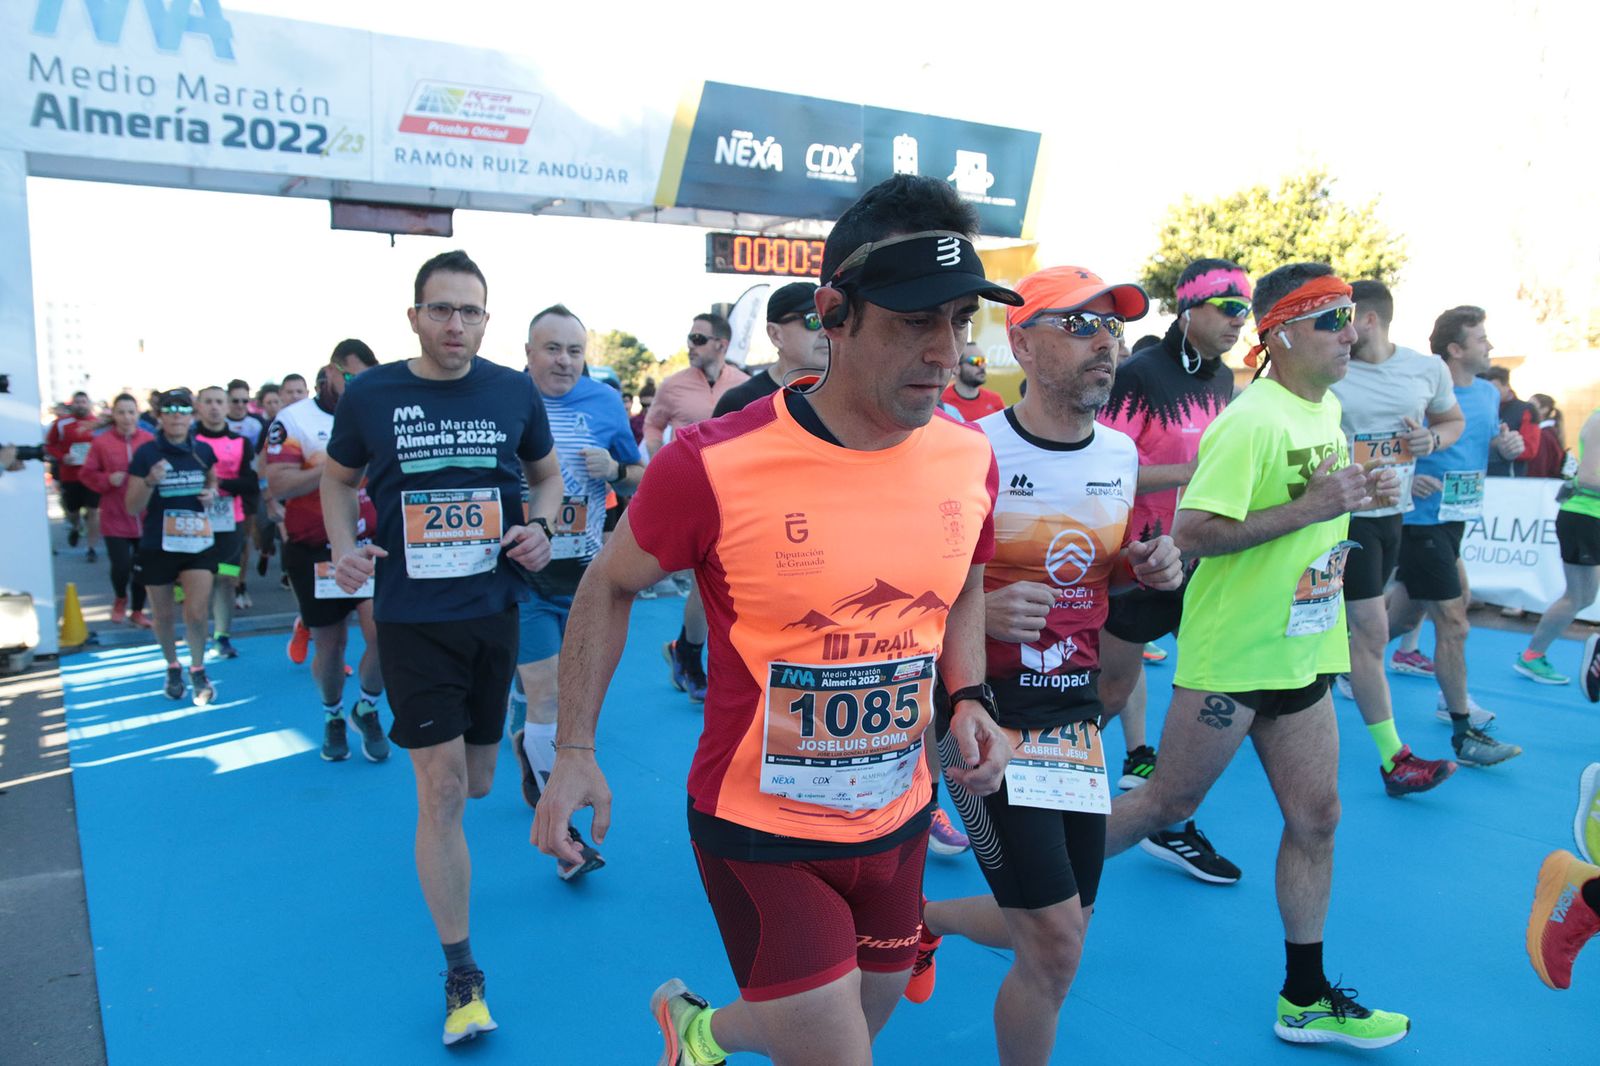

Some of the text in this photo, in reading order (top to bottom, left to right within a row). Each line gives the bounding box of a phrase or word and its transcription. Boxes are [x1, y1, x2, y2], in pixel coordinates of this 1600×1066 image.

[28, 52, 331, 117] Medio Maratón
[30, 92, 210, 145] Almería
[471, 126, 509, 139] Oficial
[715, 133, 783, 172] NEXA
[805, 142, 861, 176] CDX
[394, 147, 629, 184] RAMÓN RUIZ ANDÚJAR
[394, 418, 497, 435] Medio Maratón
[396, 431, 455, 449] Almería
[397, 446, 498, 460] RAMÓN RUIZ ANDÚJAR
[1367, 441, 1402, 457] 764
[424, 503, 483, 530] 266
[423, 528, 484, 539] ARMANDO DIAZ
[775, 549, 824, 562] Diputación
[776, 558, 825, 569] de Granada
[1462, 545, 1539, 567] CIUDAD
[822, 667, 881, 679] Medio Maratón
[1019, 670, 1090, 693] Europack
[821, 677, 857, 687] Almería
[789, 683, 920, 738] 1085
[797, 731, 908, 752] JOSELUIS GOMA
[1023, 745, 1064, 756] GABRIEL
[1065, 748, 1089, 760] JESUS
[771, 776, 796, 785] NEXA
[812, 775, 832, 784] CDX
